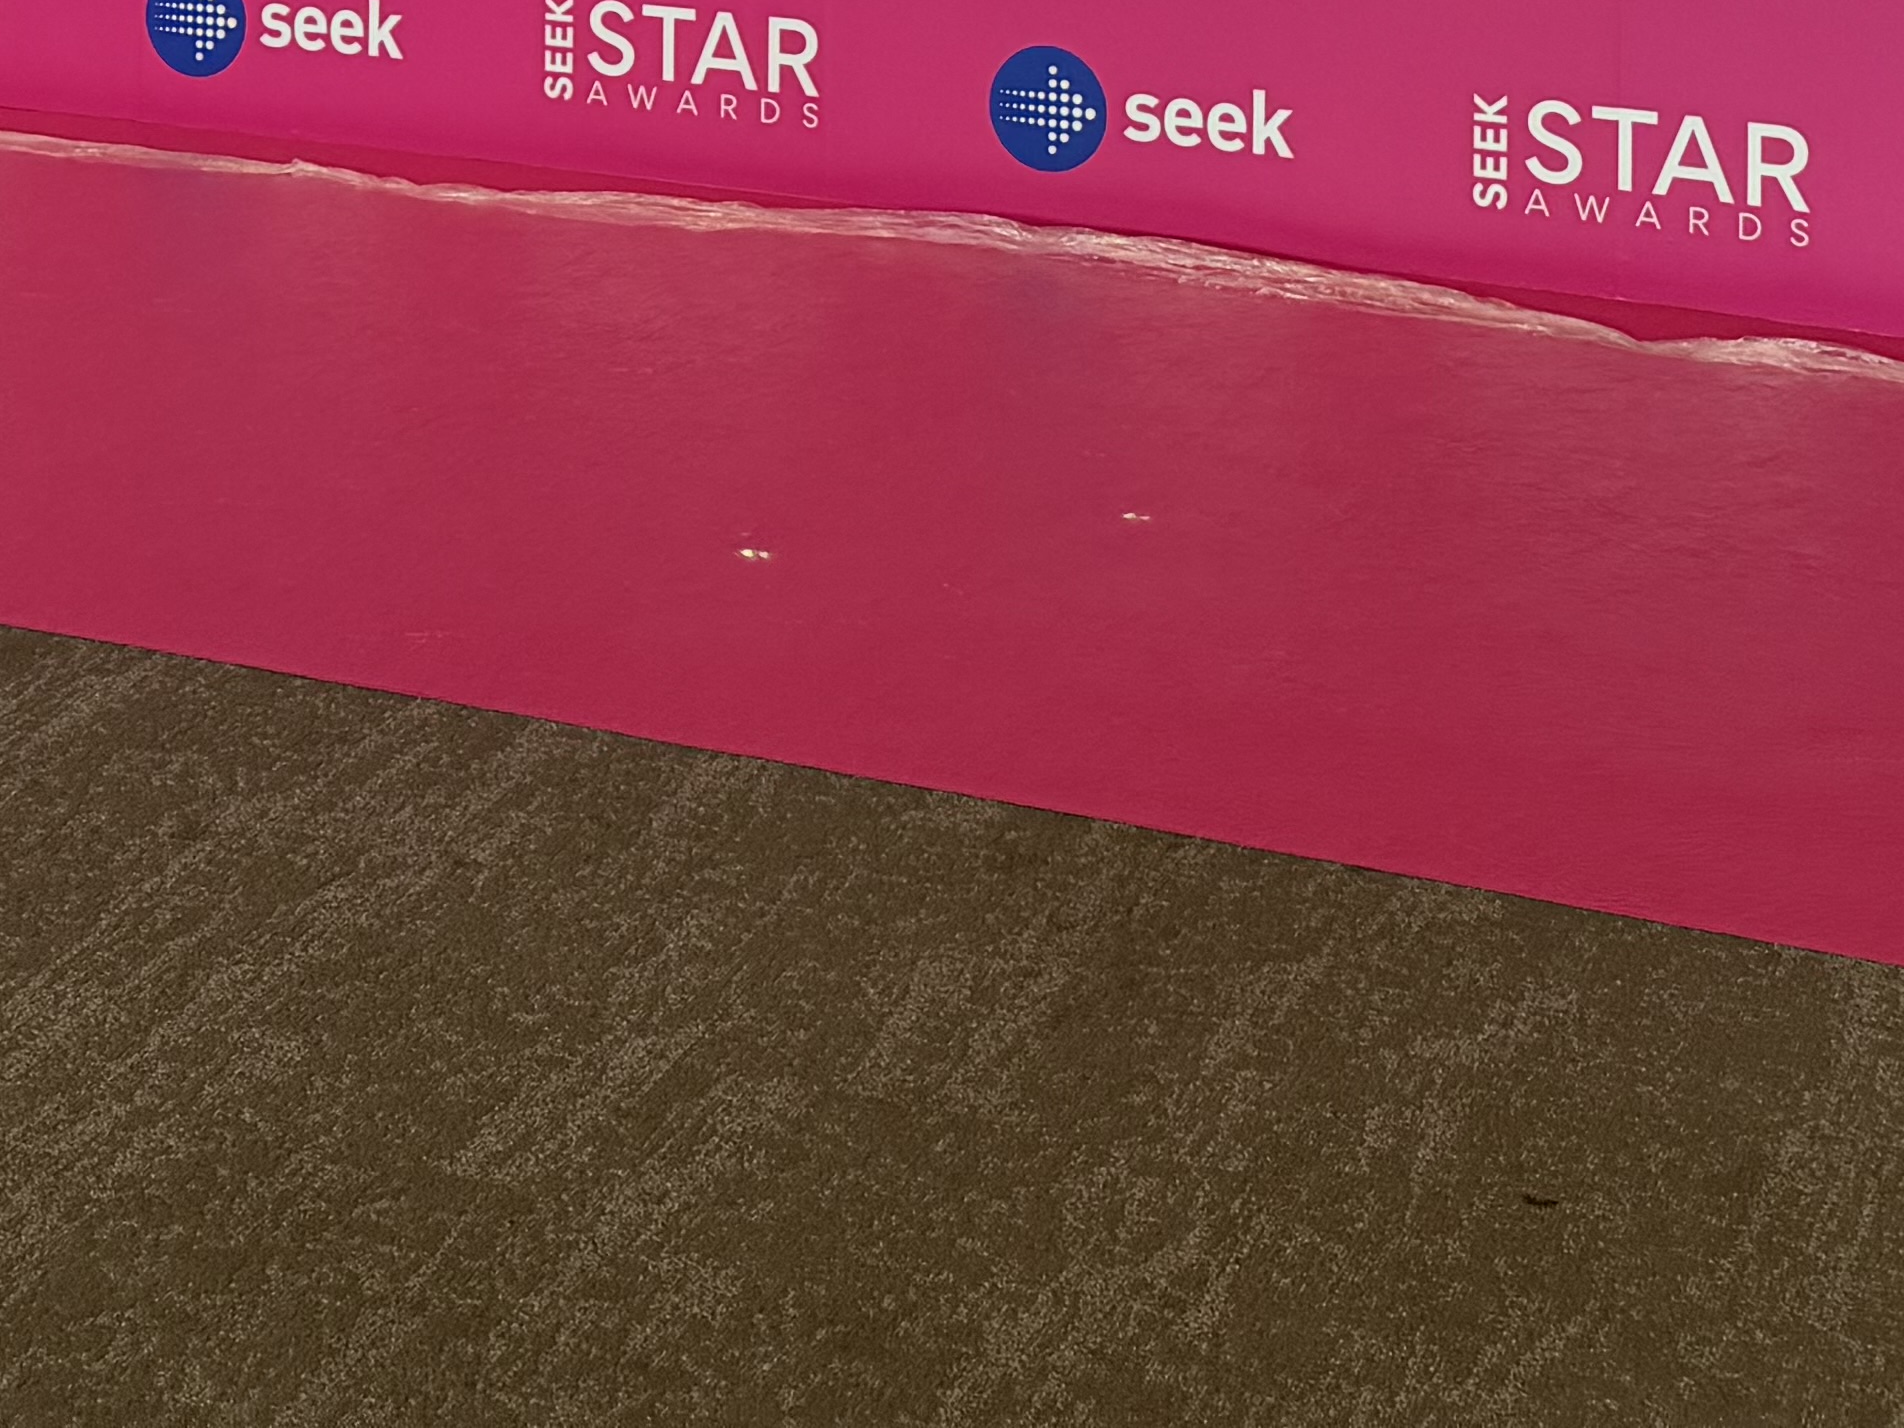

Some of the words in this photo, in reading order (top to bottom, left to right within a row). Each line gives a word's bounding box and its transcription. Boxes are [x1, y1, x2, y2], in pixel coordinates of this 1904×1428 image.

[585, 79, 820, 130] AWARDS
[1122, 87, 1296, 160] seek
[1471, 92, 1510, 211] SEEK
[1523, 98, 1812, 215] STAR
[1523, 187, 1811, 249] AWARDS
